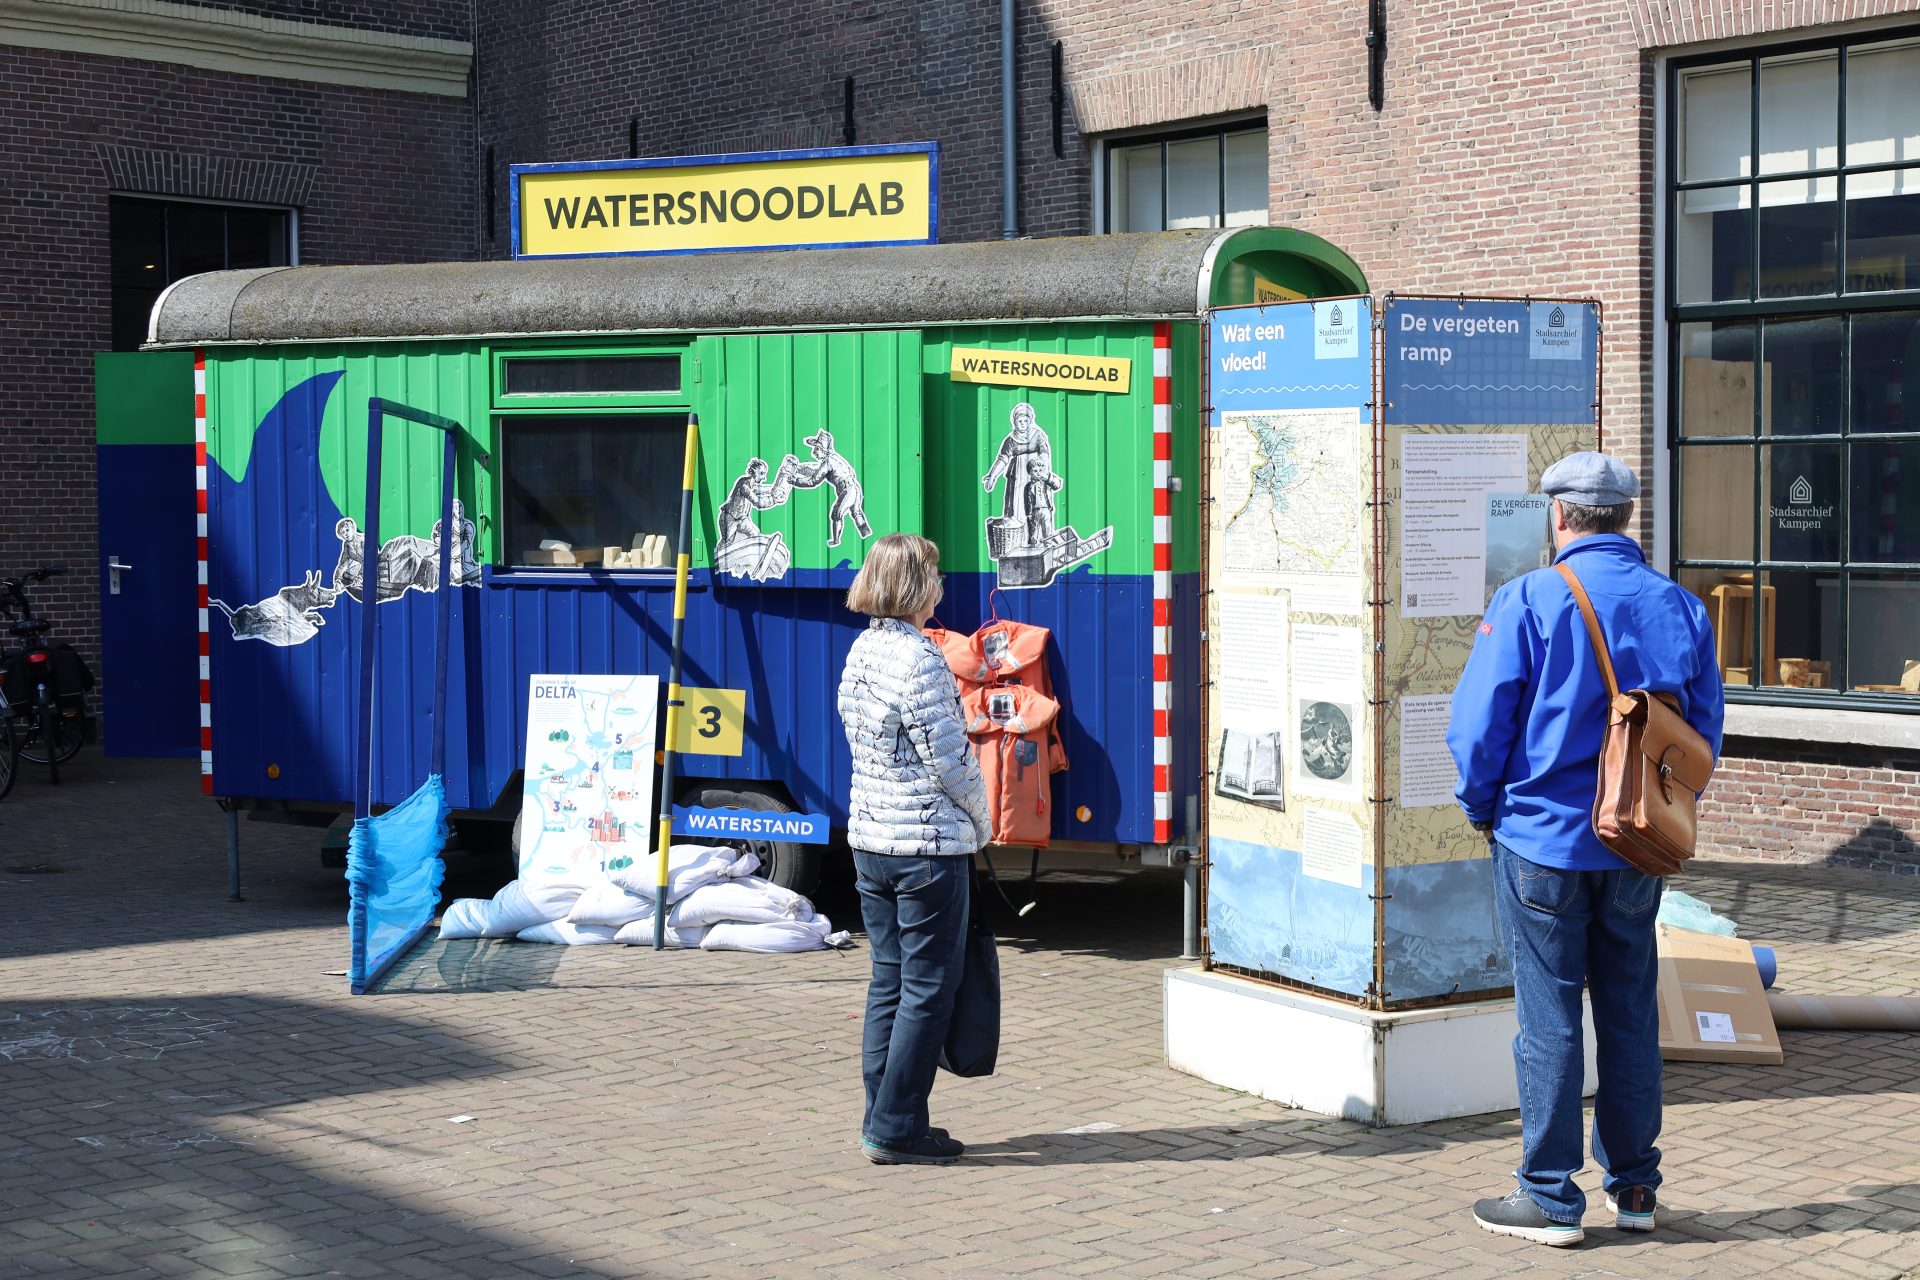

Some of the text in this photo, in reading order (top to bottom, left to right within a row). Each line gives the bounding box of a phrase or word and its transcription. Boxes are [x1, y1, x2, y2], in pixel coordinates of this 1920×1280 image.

[543, 181, 905, 230] WATERSNOODLAB
[1400, 313, 1519, 337] De vergeten
[1221, 324, 1285, 343] Wat een
[1318, 327, 1353, 337] Stadsarchief
[1535, 328, 1577, 338] Stadsarchief
[1324, 337, 1348, 346] Kampen
[1542, 338, 1570, 347] Kampen
[1221, 350, 1267, 372] vloed!
[1400, 346, 1452, 366] ramp
[962, 358, 1119, 382] WATERSNOODLAB
[1491, 500, 1546, 509] DE VERGETEN
[1491, 509, 1514, 517] RAMP
[1768, 505, 1834, 517] Stadsarchief
[1778, 518, 1822, 531] Kampen
[535, 685, 577, 699] DELTA
[697, 705, 722, 739] 3
[615, 733, 623, 745] 5
[592, 762, 600, 773] 4
[553, 801, 560, 812] 3
[588, 818, 595, 829] 2
[688, 814, 814, 836] WATERSTAND
[600, 861, 605, 872] 1
